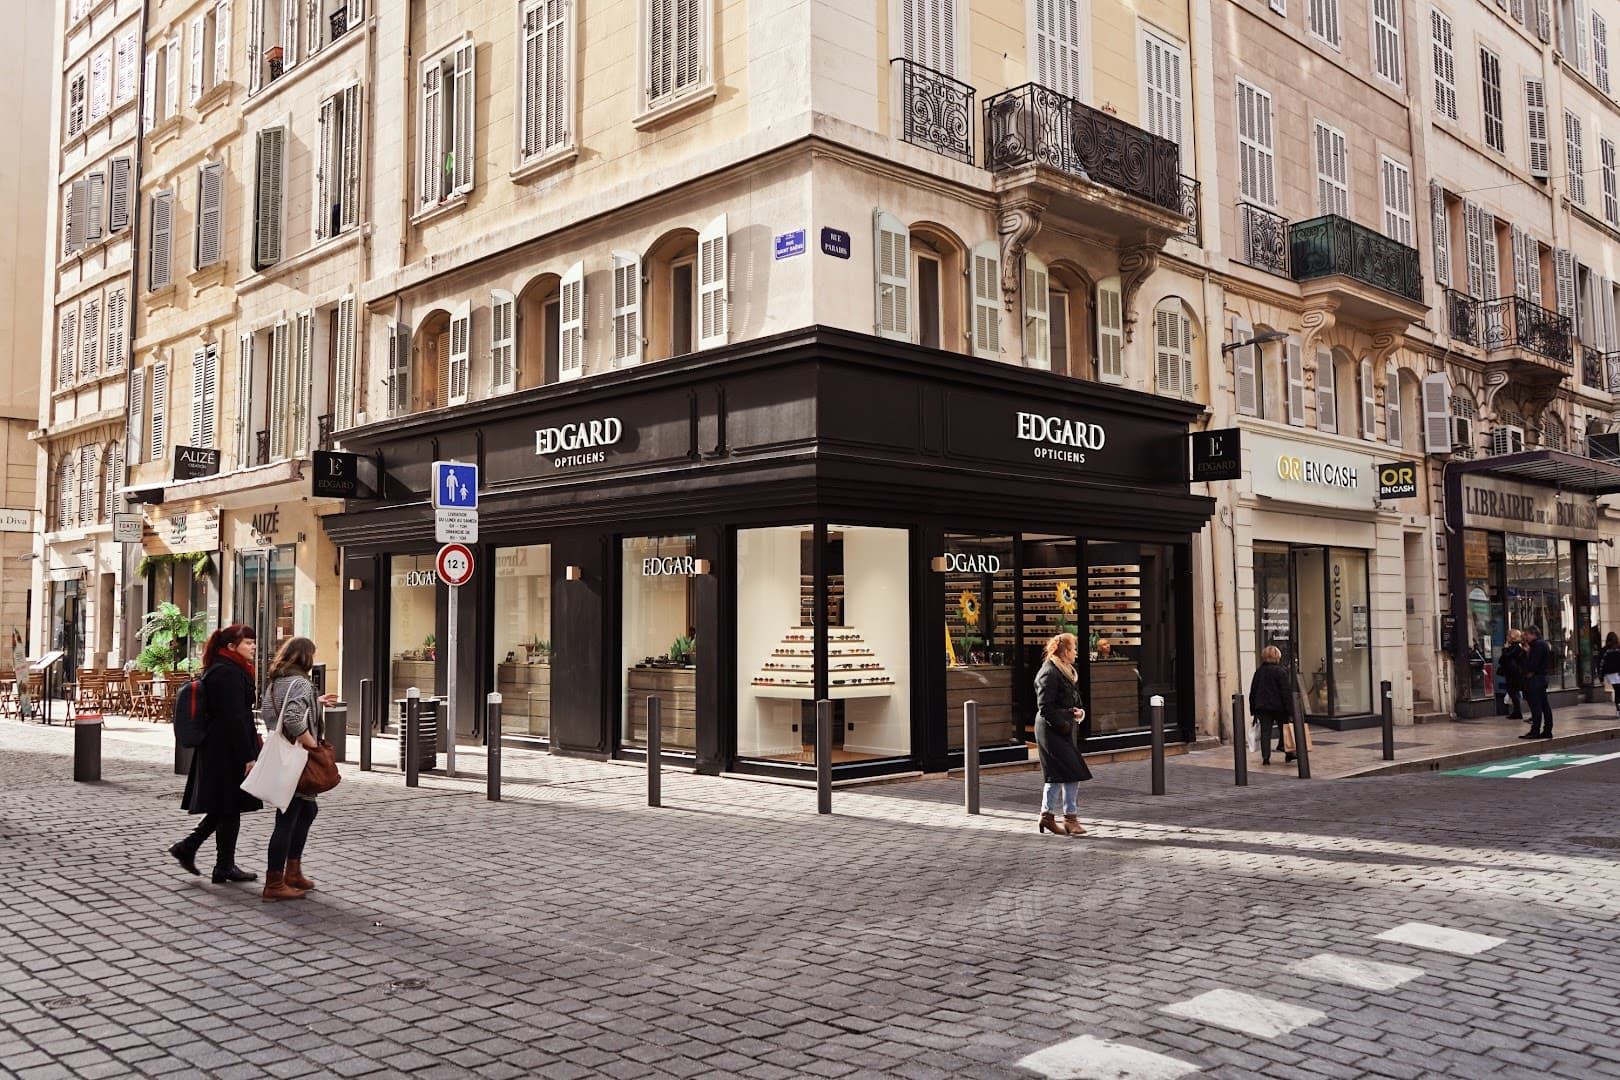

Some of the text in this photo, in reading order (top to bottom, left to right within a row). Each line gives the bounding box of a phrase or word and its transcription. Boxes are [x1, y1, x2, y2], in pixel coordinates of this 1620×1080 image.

[830, 233, 842, 242] RUE
[824, 243, 848, 255] PARADIS
[535, 417, 622, 455] EDGARD
[1016, 411, 1105, 451] EDGARD
[1209, 435, 1223, 456] E
[180, 450, 216, 465] ALIZÉ
[554, 451, 605, 468] OPTICIENS
[1033, 447, 1086, 464] OPTICIENS
[329, 457, 343, 476] E
[1198, 460, 1236, 472] EDGARD
[1277, 455, 1359, 488] OR EN CASH
[318, 479, 354, 489] EDGARD
[1381, 467, 1413, 486] OR
[1381, 485, 1415, 494] EN CASH
[1465, 486, 1535, 523] LIBRAIRIE
[6, 516, 27, 525] Diva
[251, 504, 280, 535] ALIZÉ
[447, 559, 465, 569] 12 t
[642, 555, 696, 576] EDGAR
[944, 552, 1000, 574] DGARD
[406, 569, 437, 587] EDGA
[1333, 564, 1342, 626] Vente
